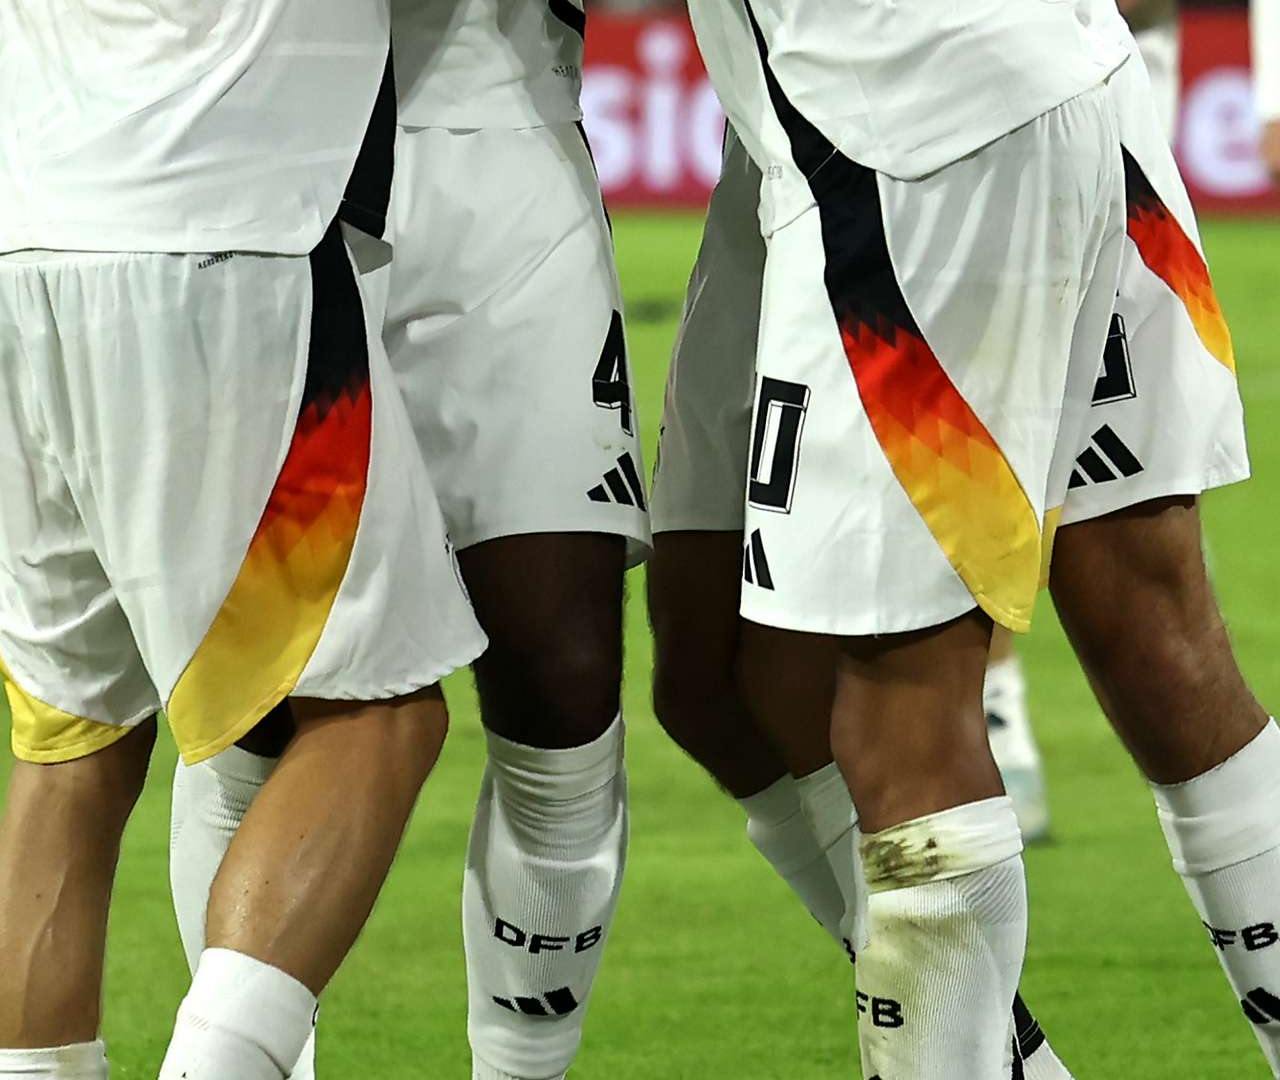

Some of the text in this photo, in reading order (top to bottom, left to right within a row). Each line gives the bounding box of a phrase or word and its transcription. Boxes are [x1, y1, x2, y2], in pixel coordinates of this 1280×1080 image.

[592, 308, 634, 437] 4
[493, 917, 603, 954] DFB
[1202, 920, 1280, 952] FB
